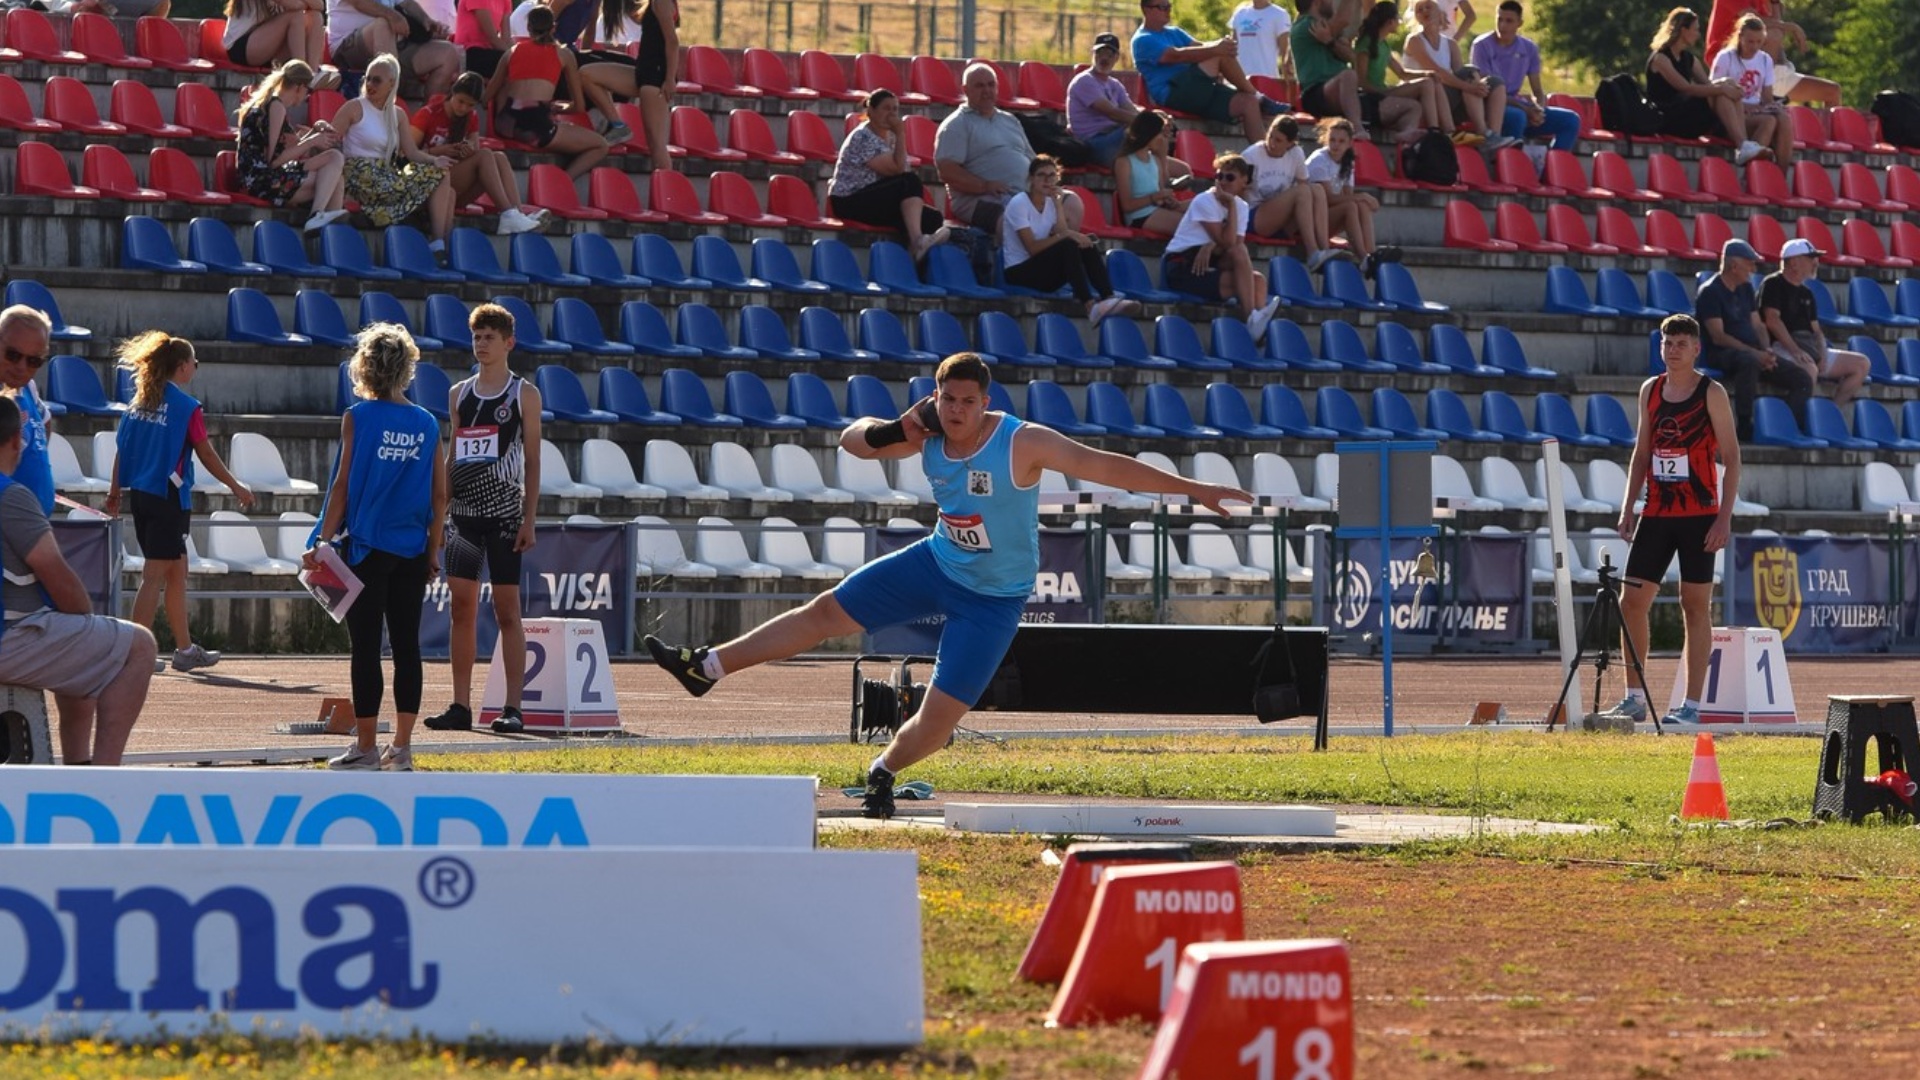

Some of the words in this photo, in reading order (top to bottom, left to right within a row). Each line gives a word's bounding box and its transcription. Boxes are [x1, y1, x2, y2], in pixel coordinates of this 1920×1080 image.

[463, 439, 491, 456] 137
[1659, 460, 1676, 474] 12
[947, 525, 980, 546] 140
[540, 572, 613, 610] VISA
[1806, 568, 1851, 597] ГРАД
[521, 641, 547, 702] 2
[576, 642, 602, 703] 2
[1706, 648, 1722, 704] 1
[1757, 649, 1775, 705] 1
[1134, 889, 1236, 914] MONDO
[1228, 970, 1342, 1000] MONDO
[1237, 1026, 1335, 1080] 18
